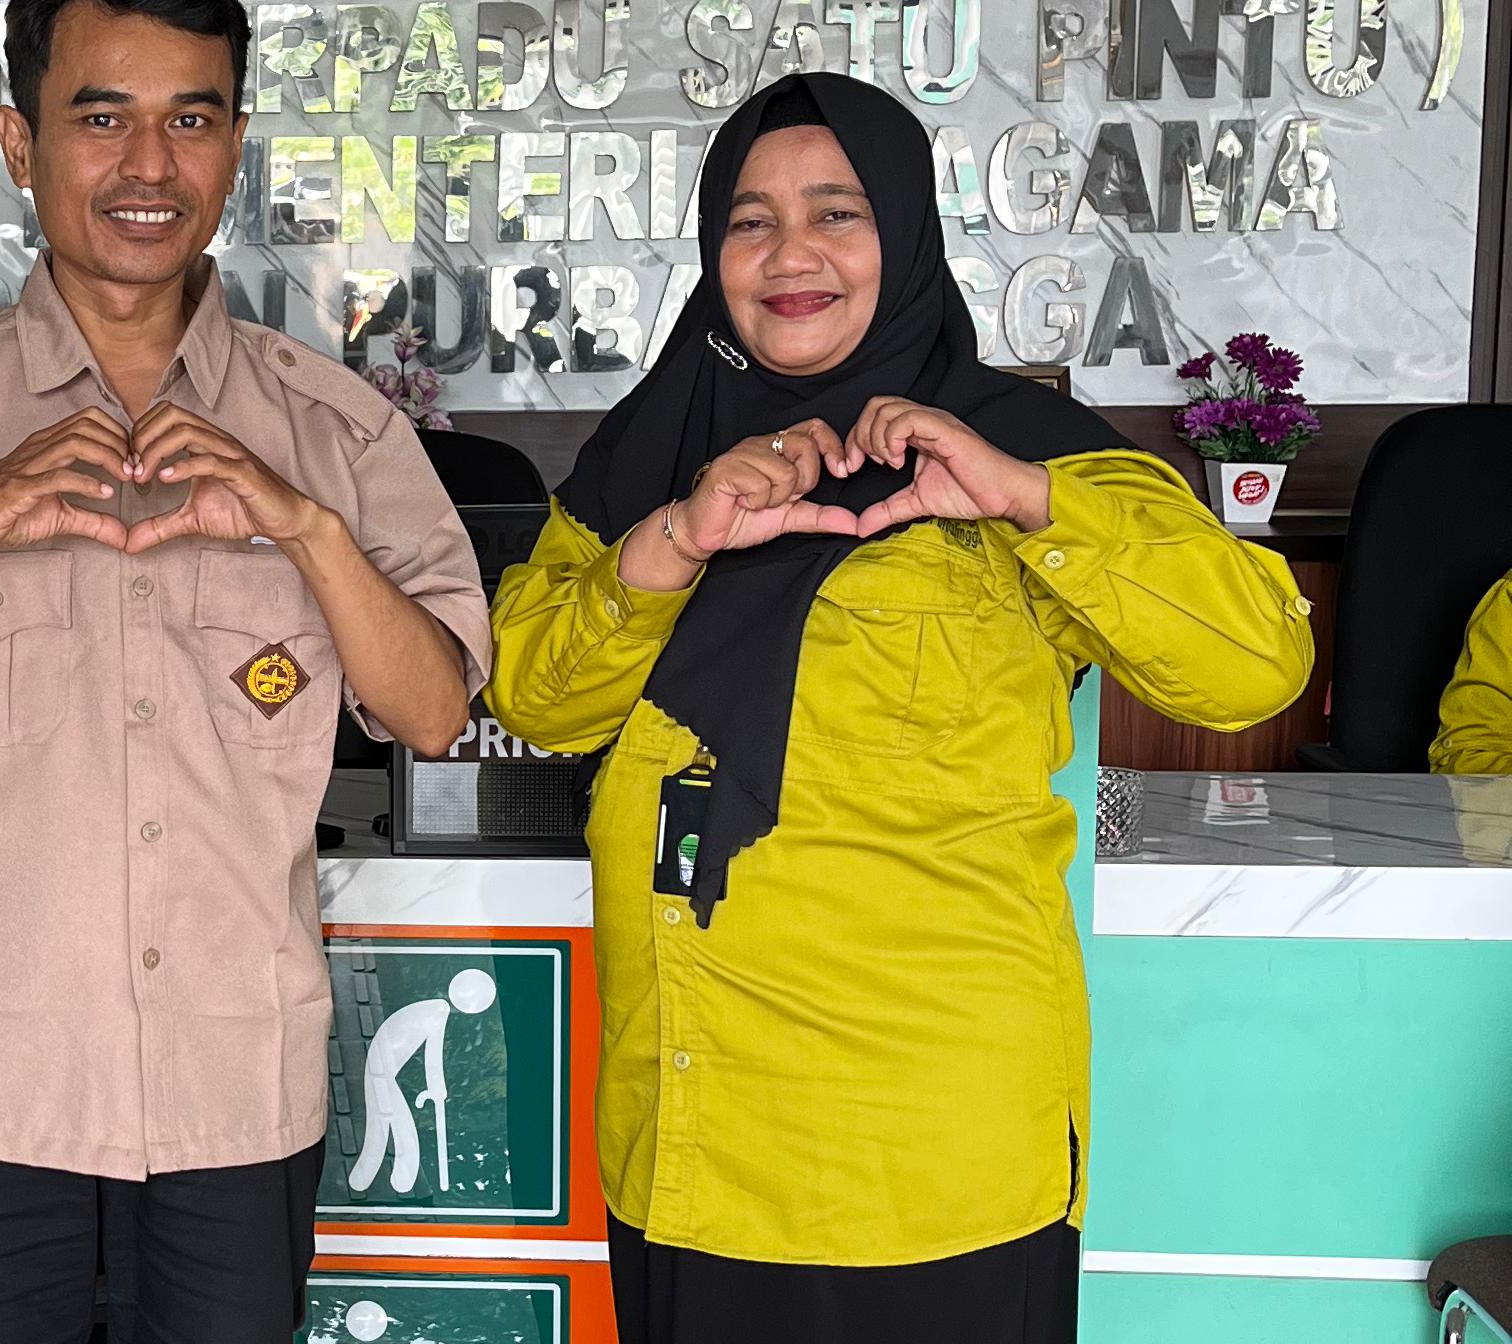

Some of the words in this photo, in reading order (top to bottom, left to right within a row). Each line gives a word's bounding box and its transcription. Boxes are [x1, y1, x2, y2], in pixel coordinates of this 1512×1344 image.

[931, 118, 1346, 235] AGAMA
[343, 256, 1171, 375] PURBGGA
[449, 717, 584, 758] PRI
